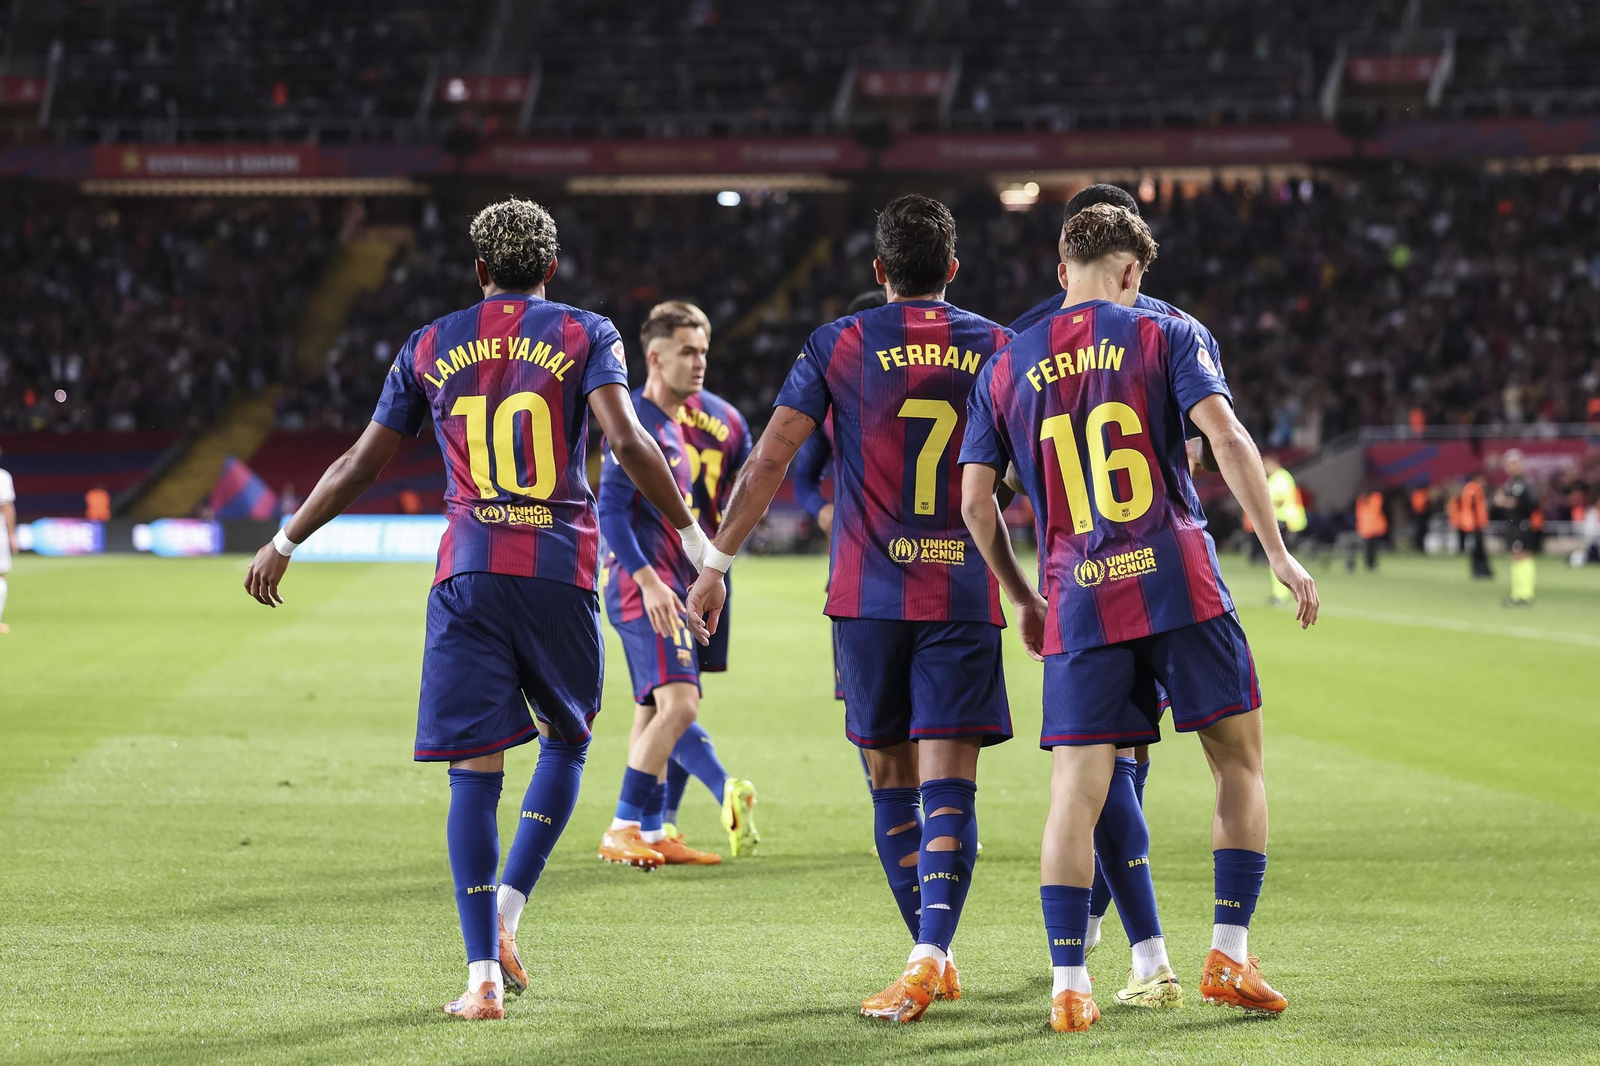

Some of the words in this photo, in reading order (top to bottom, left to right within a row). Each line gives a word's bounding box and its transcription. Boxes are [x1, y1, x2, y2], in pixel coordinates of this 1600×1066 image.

[423, 337, 502, 389] LAMINE
[507, 336, 576, 382] YAMAL
[876, 343, 982, 374] FERRAN
[1025, 338, 1126, 392] FERMÍN
[450, 391, 557, 500] 10
[896, 398, 958, 515] 7
[1039, 401, 1154, 535] 16
[506, 504, 552, 515] UNHCR
[508, 513, 553, 525] ACNUR
[920, 538, 965, 551] UNHCR
[920, 549, 965, 561] ACNUR
[1105, 547, 1154, 567] UNHCR
[1108, 557, 1157, 578] ACNUR
[1053, 938, 1082, 946] BARÇA
